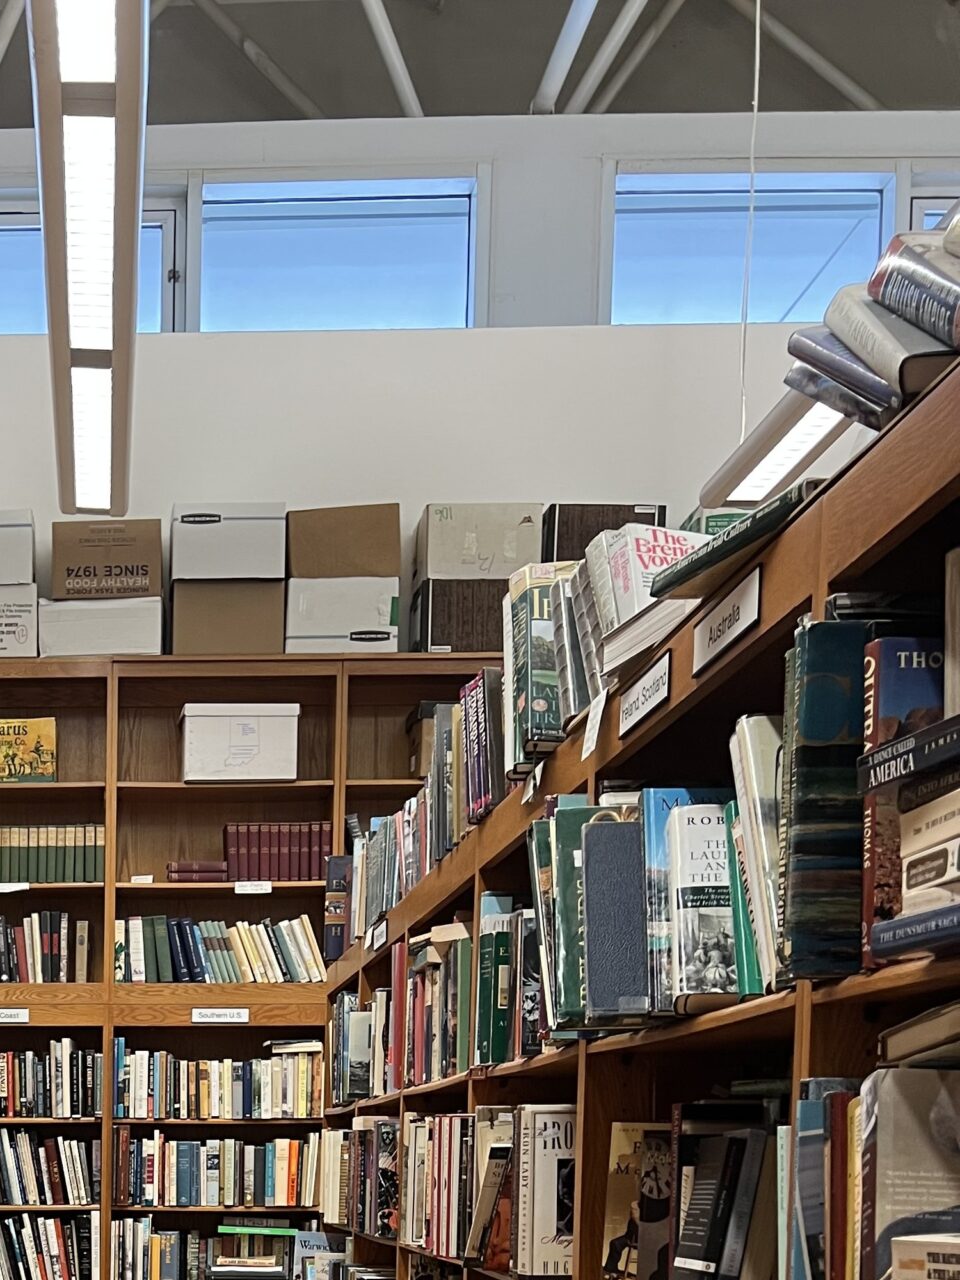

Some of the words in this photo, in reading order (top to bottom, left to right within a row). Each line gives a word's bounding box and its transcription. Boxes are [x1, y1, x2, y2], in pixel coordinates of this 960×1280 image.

[886, 271, 921, 314] BRITISH
[920, 294, 951, 339] EMPIRE
[645, 528, 688, 546] The
[724, 518, 752, 541] Culture
[634, 537, 695, 557] Brend
[66, 565, 97, 577] 1974
[103, 564, 149, 576] SINCE
[66, 578, 97, 587] FOOD
[101, 577, 149, 586] HEALTHY
[66, 587, 92, 595] FORCE
[116, 586, 149, 594] HUNGER
[707, 603, 741, 648] Australia
[897, 650, 944, 669] THO
[621, 697, 640, 723] Ireland
[640, 670, 667, 706] Scotland
[14, 737, 27, 746] Co.
[868, 753, 915, 788] AMERICA
[924, 732, 958, 754] JAMES
[686, 816, 725, 826] ROB
[704, 840, 726, 849] TH
[863, 808, 873, 870] THOMAS
[689, 873, 722, 883] THE
[684, 893, 708, 901] Charles
[880, 931, 893, 944] THE
[894, 923, 937, 941] DUNSMUIR
[939, 916, 958, 933] SAGA
[197, 1011, 230, 1020] Southern
[230, 1011, 243, 1019] U.S.
[521, 1126, 530, 1158] IRON
[543, 1121, 573, 1150] IRO
[520, 1160, 529, 1189] LADY
[542, 1260, 569, 1275] HUG
